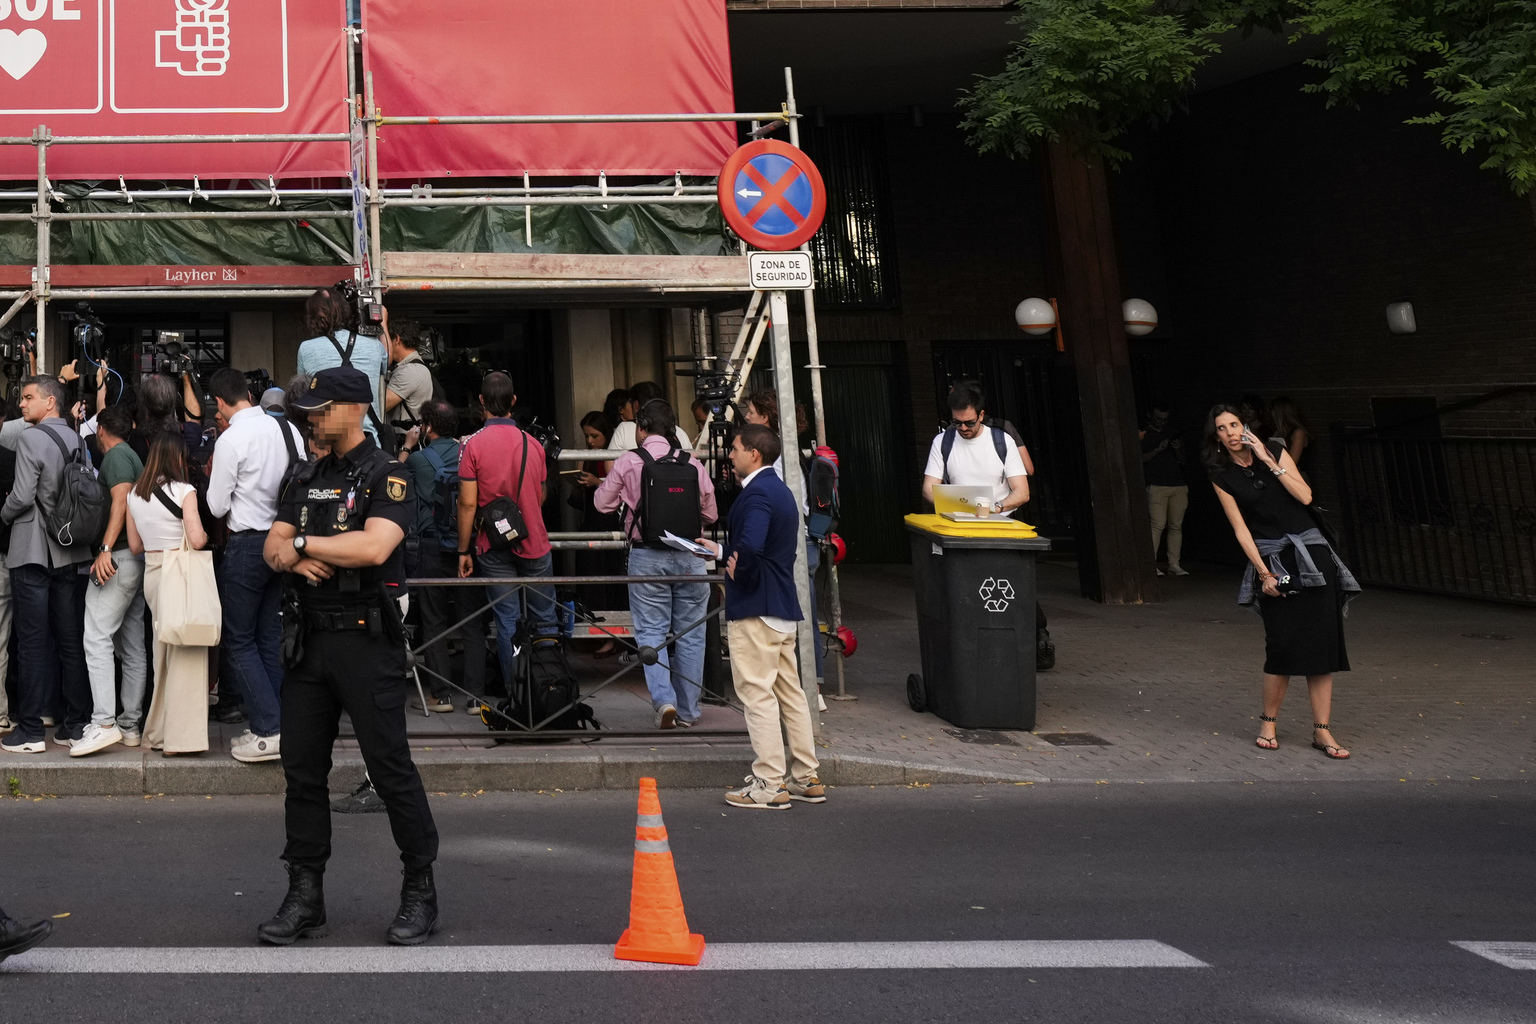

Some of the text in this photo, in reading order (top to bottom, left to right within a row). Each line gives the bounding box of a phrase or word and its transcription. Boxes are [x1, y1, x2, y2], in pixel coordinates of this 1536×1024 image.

[760, 260, 801, 269] ZONA DE
[165, 267, 217, 282] Layher
[755, 272, 808, 281] SEGURIDAD
